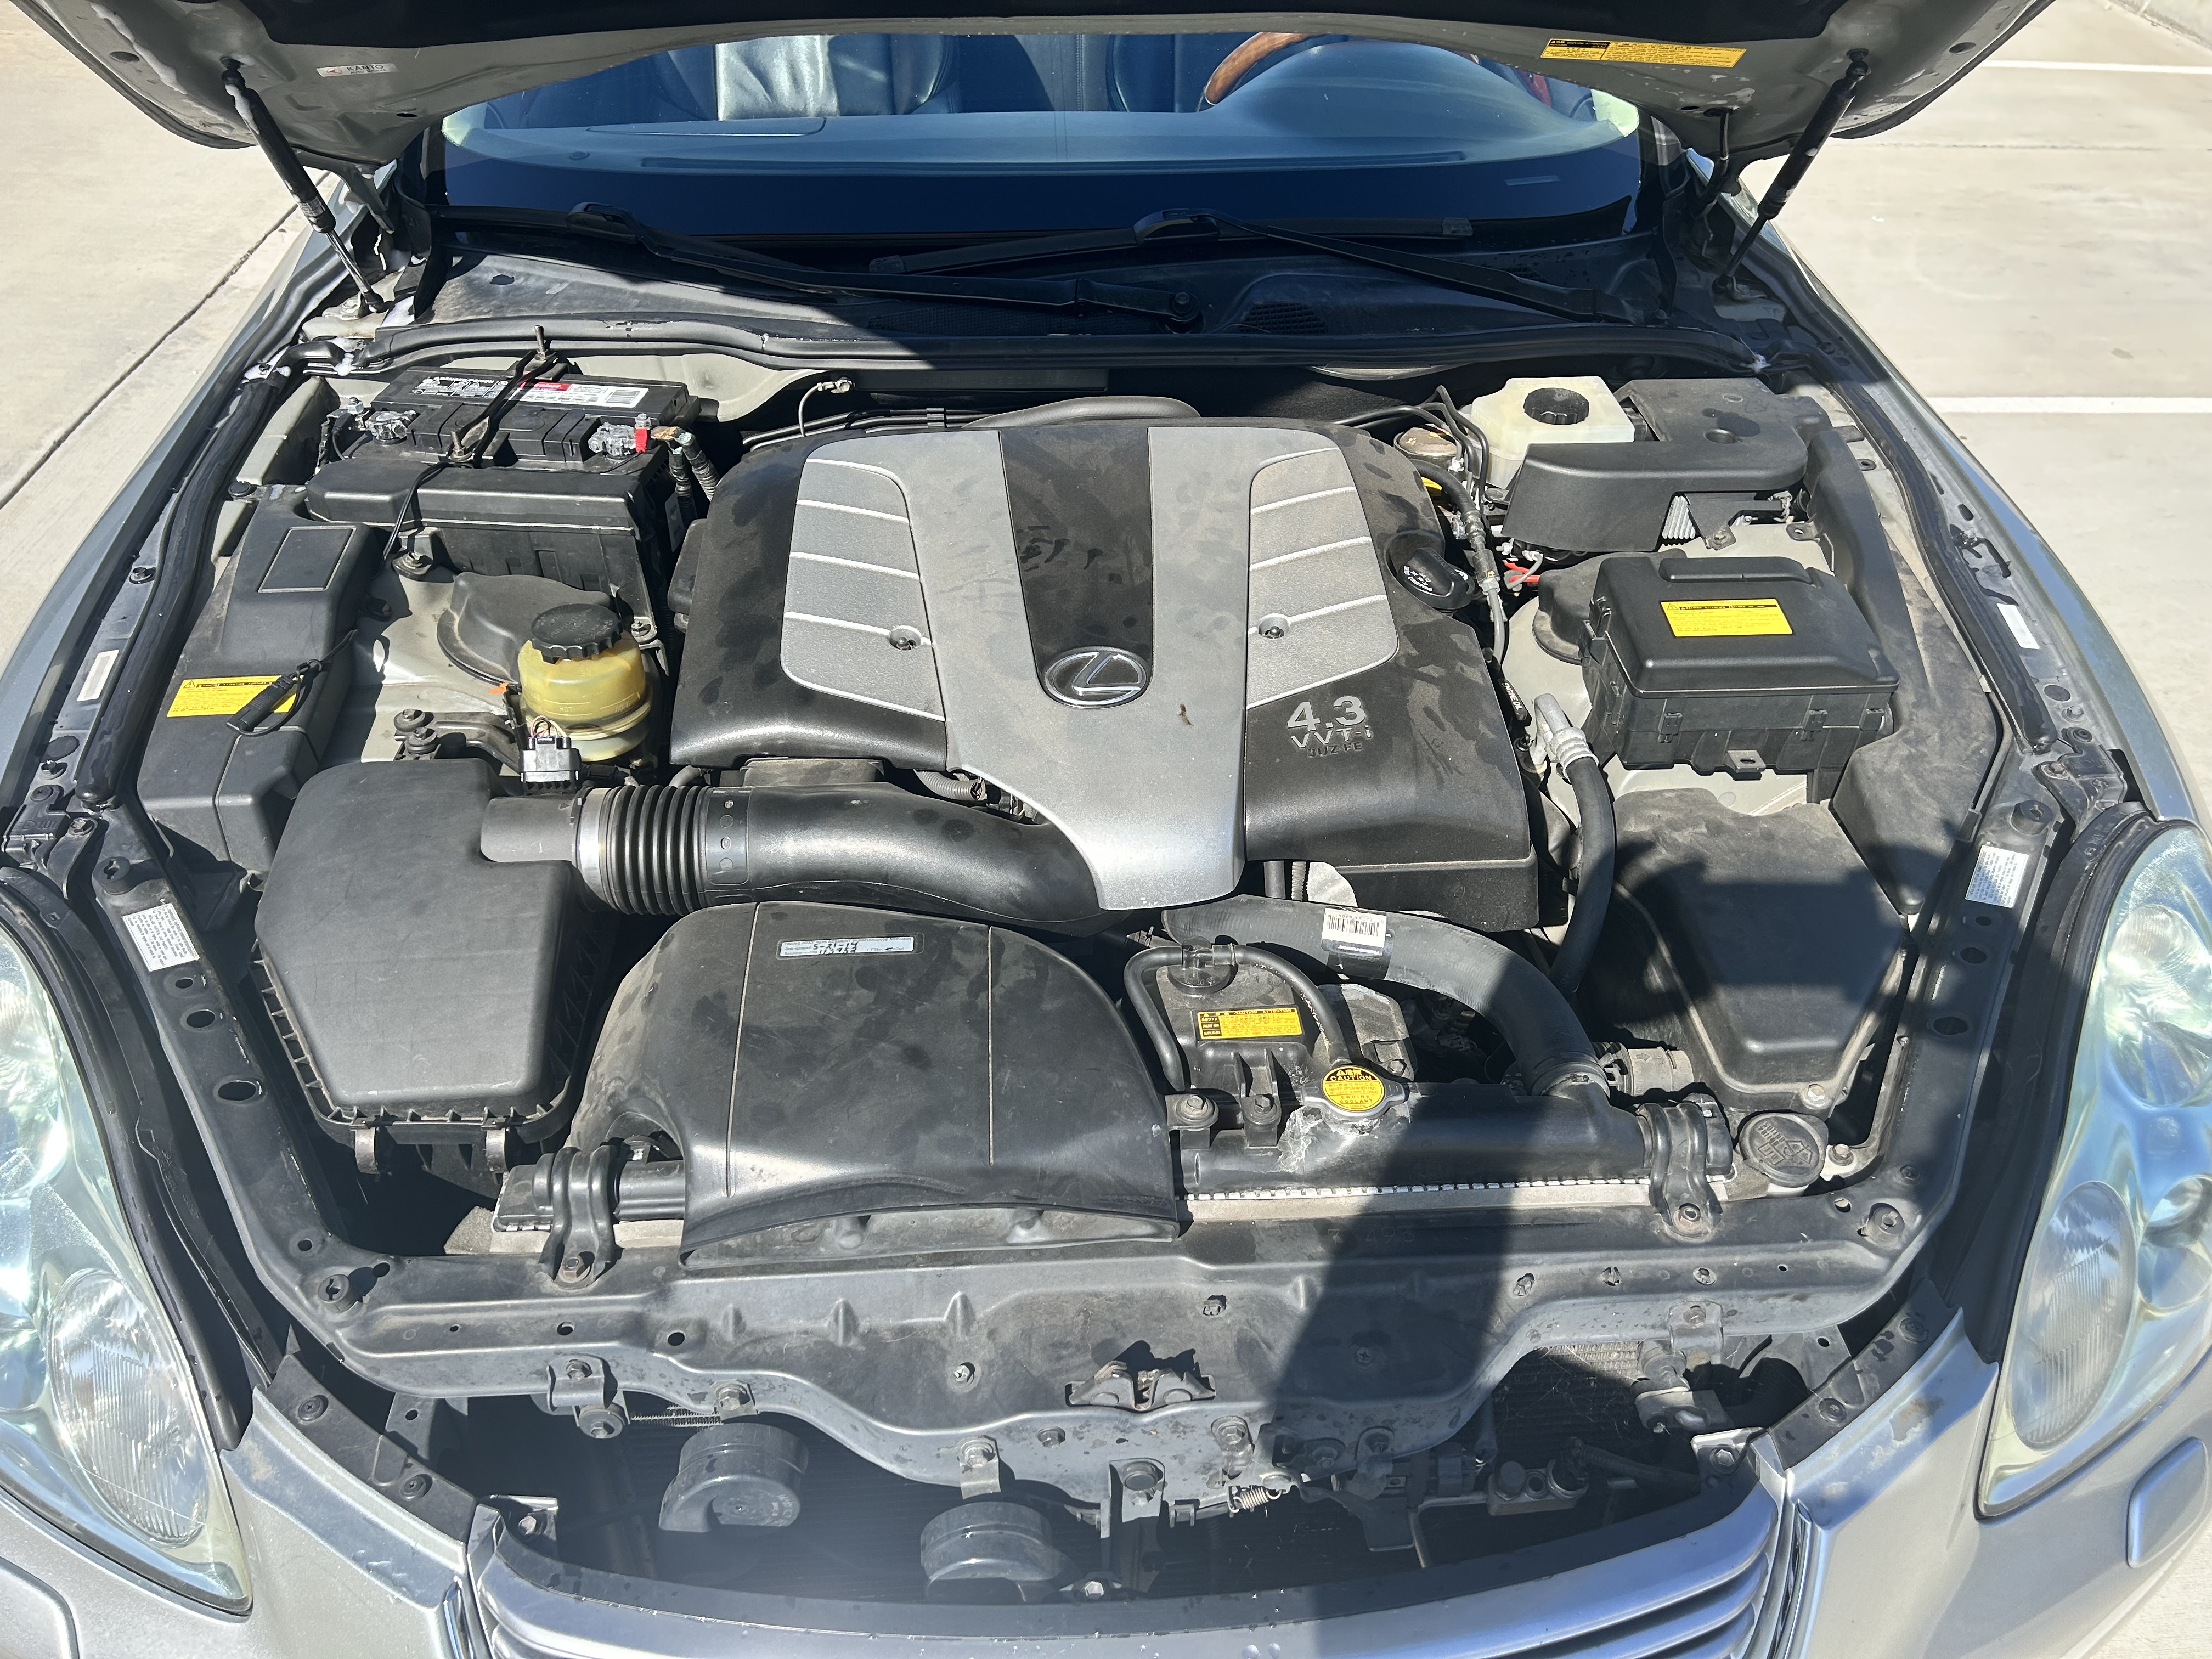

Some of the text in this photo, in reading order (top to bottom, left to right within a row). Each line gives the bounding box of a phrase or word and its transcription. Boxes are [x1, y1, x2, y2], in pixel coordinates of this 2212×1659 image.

[1287, 696, 1366, 731] 4.3
[1513, 701, 1523, 710] OIL
[1291, 725, 1373, 748] VVT-i
[1307, 742, 1364, 758] 3UZ-FE
